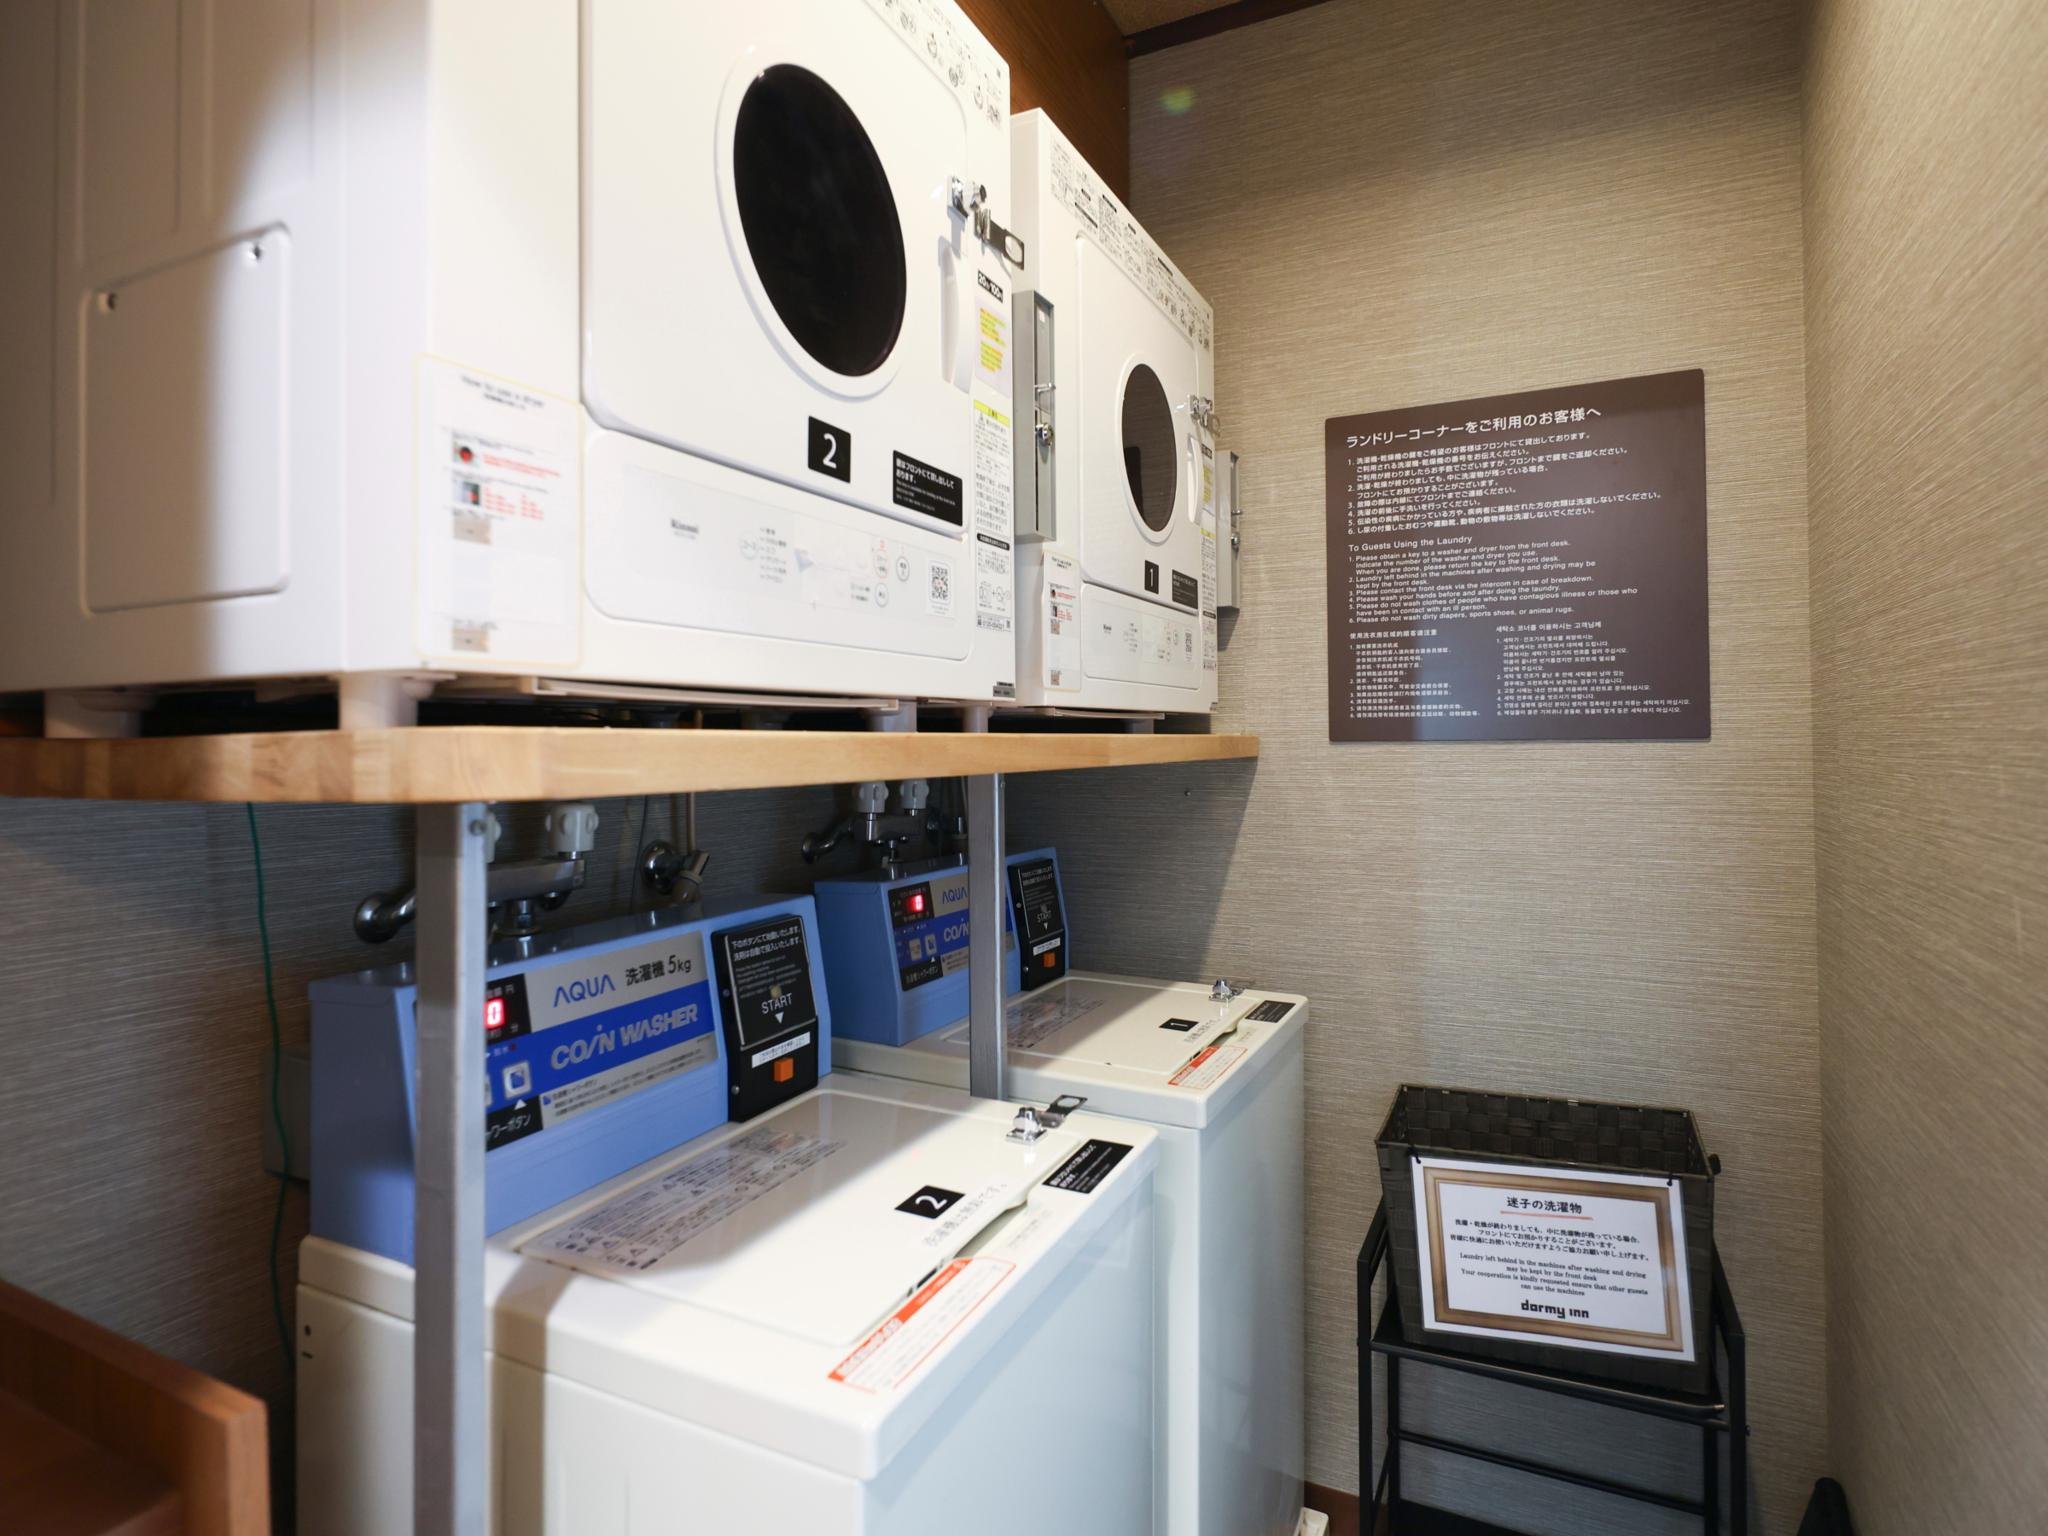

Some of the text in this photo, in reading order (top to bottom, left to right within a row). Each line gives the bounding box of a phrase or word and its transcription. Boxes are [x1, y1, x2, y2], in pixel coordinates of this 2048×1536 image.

[1346, 405, 1601, 448] ランドリーコーナーをご利用のお客様へ
[822, 432, 837, 469] 2
[1361, 541, 1390, 550] Guests
[1393, 539, 1417, 549] Using
[1436, 535, 1472, 546] Laundry
[1495, 565, 1524, 573] washing
[942, 886, 968, 904] AQUA
[553, 955, 692, 1008] AQUA 洗濯機 5kg
[761, 994, 793, 1014] START
[551, 1004, 698, 1070] COIN WASHER
[915, 1194, 948, 1210] 2
[1506, 1196, 1582, 1214] 迷子の洗濯物
